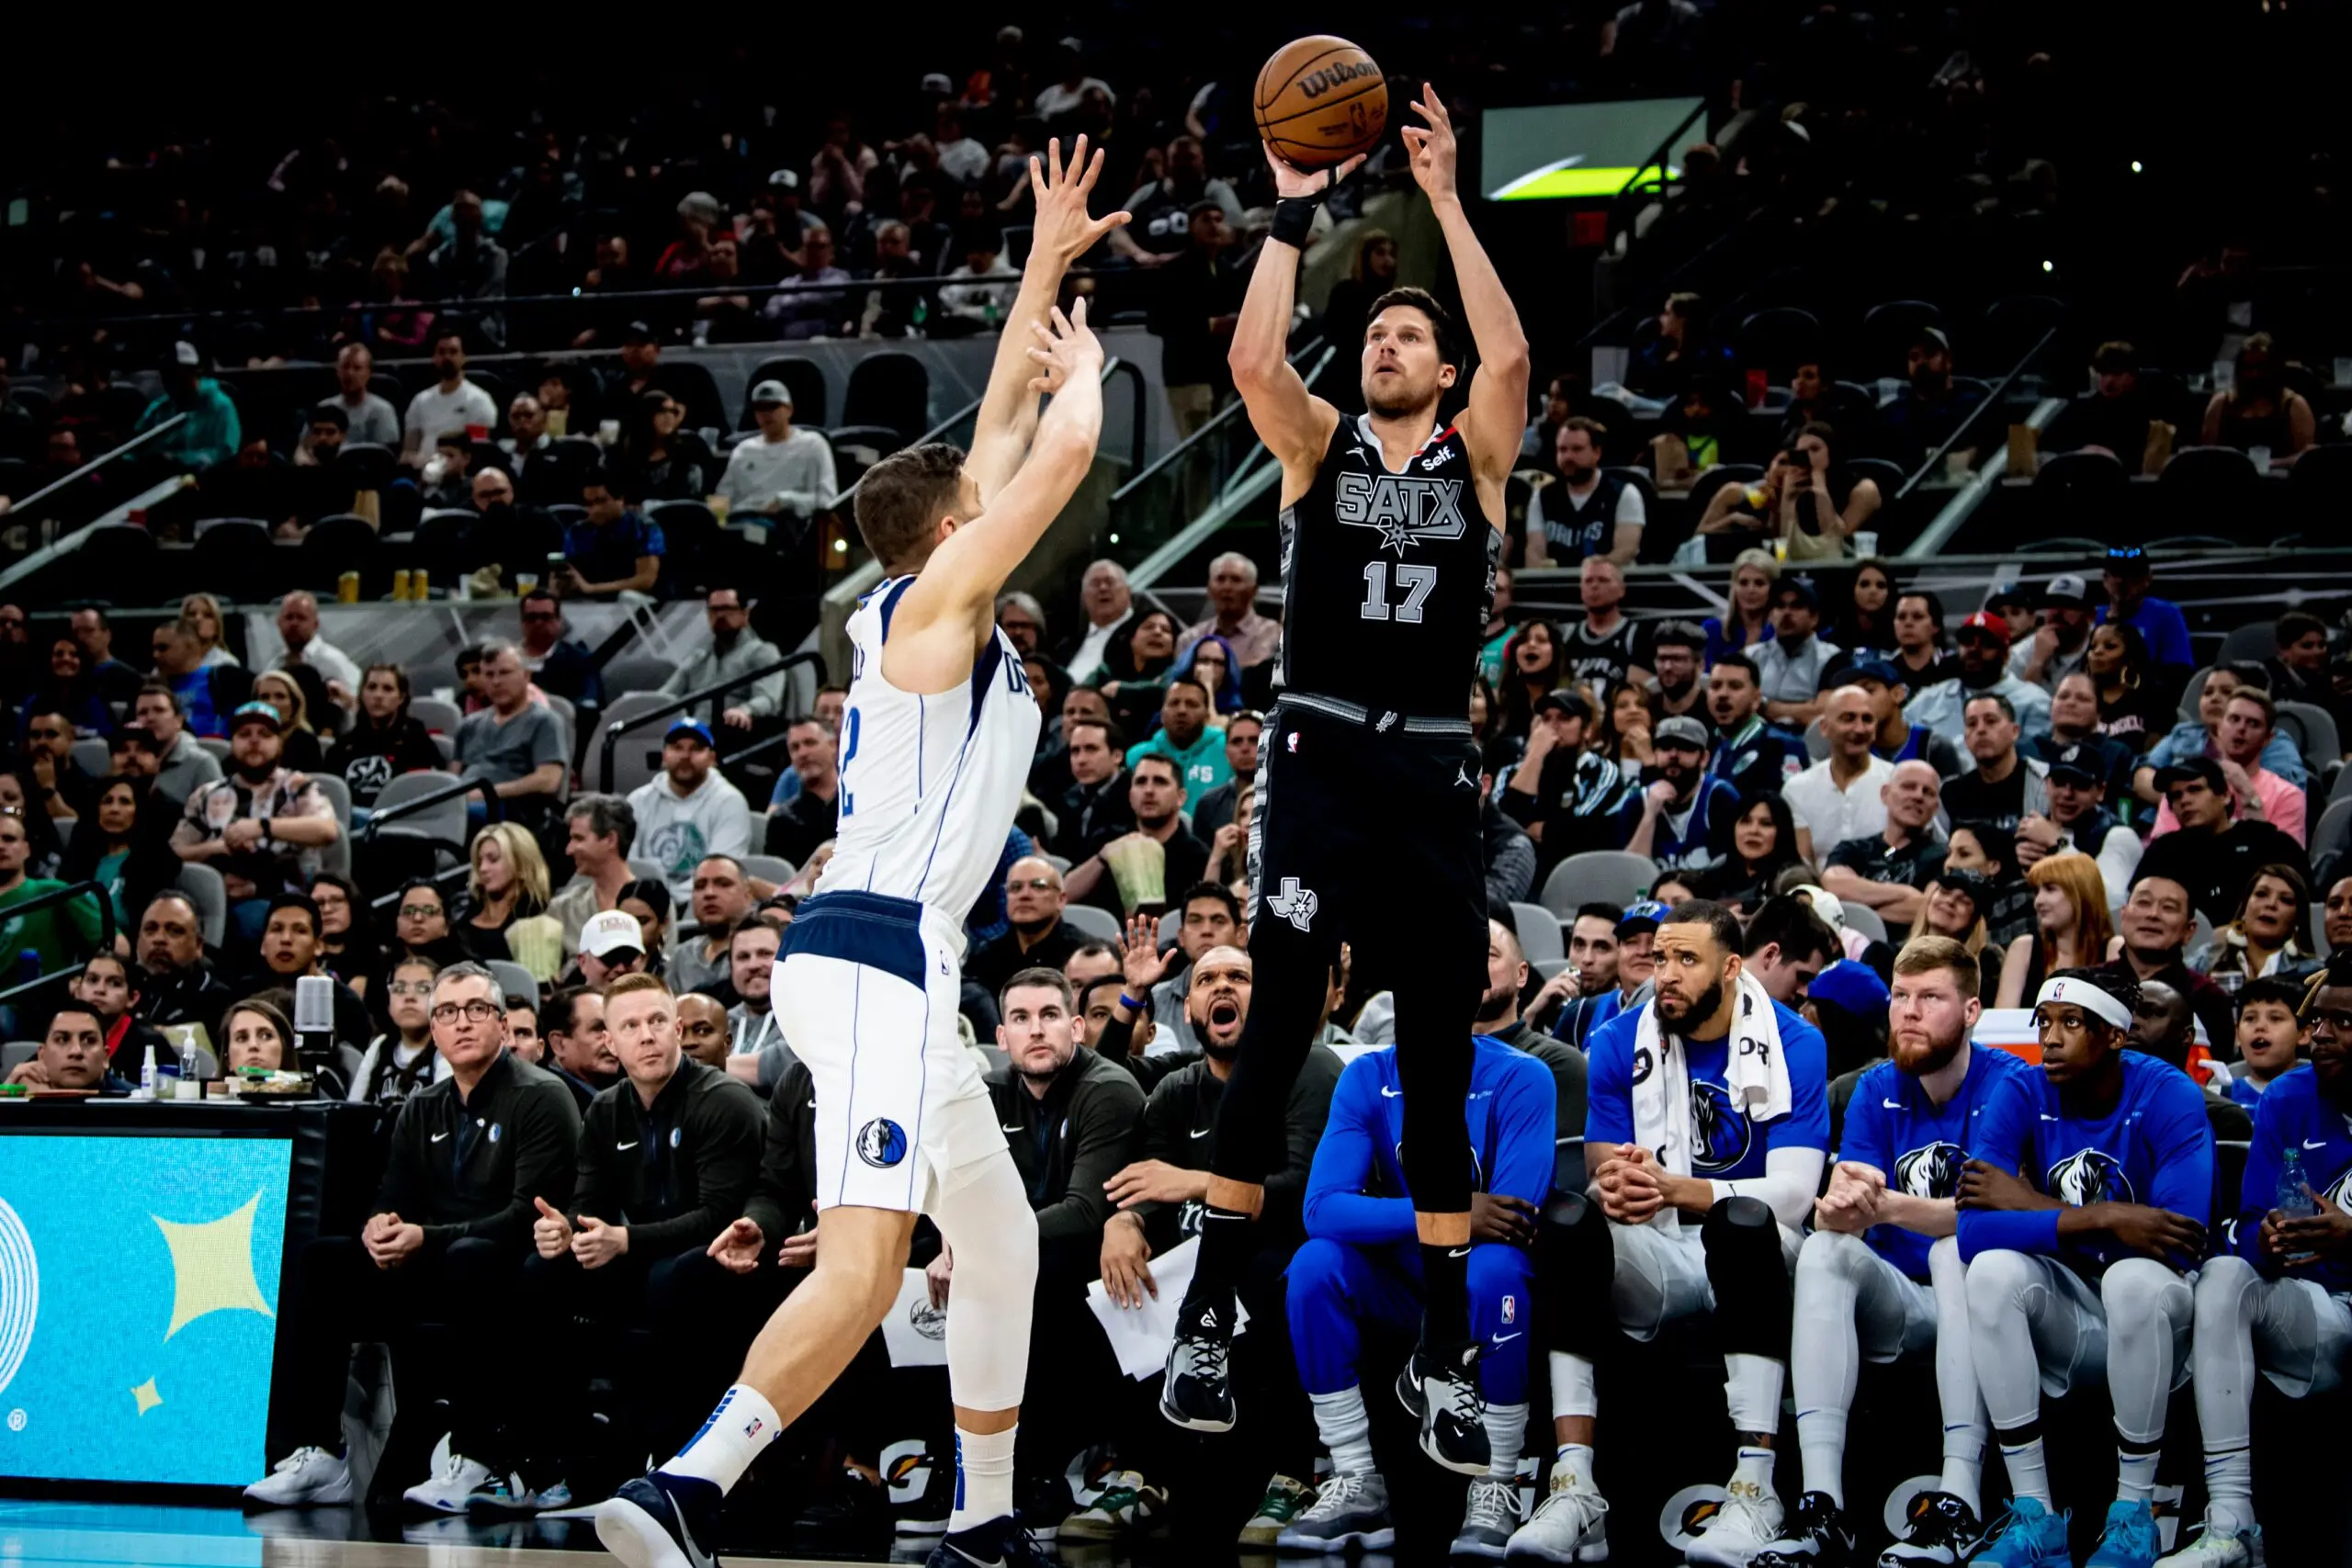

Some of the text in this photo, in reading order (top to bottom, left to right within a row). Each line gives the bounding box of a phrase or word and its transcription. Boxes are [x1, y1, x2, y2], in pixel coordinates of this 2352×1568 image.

[1296, 62, 1379, 99] Wilson
[1421, 446, 1456, 471] Self.
[1335, 471, 1466, 542] SATX
[1361, 560, 1437, 624] 17
